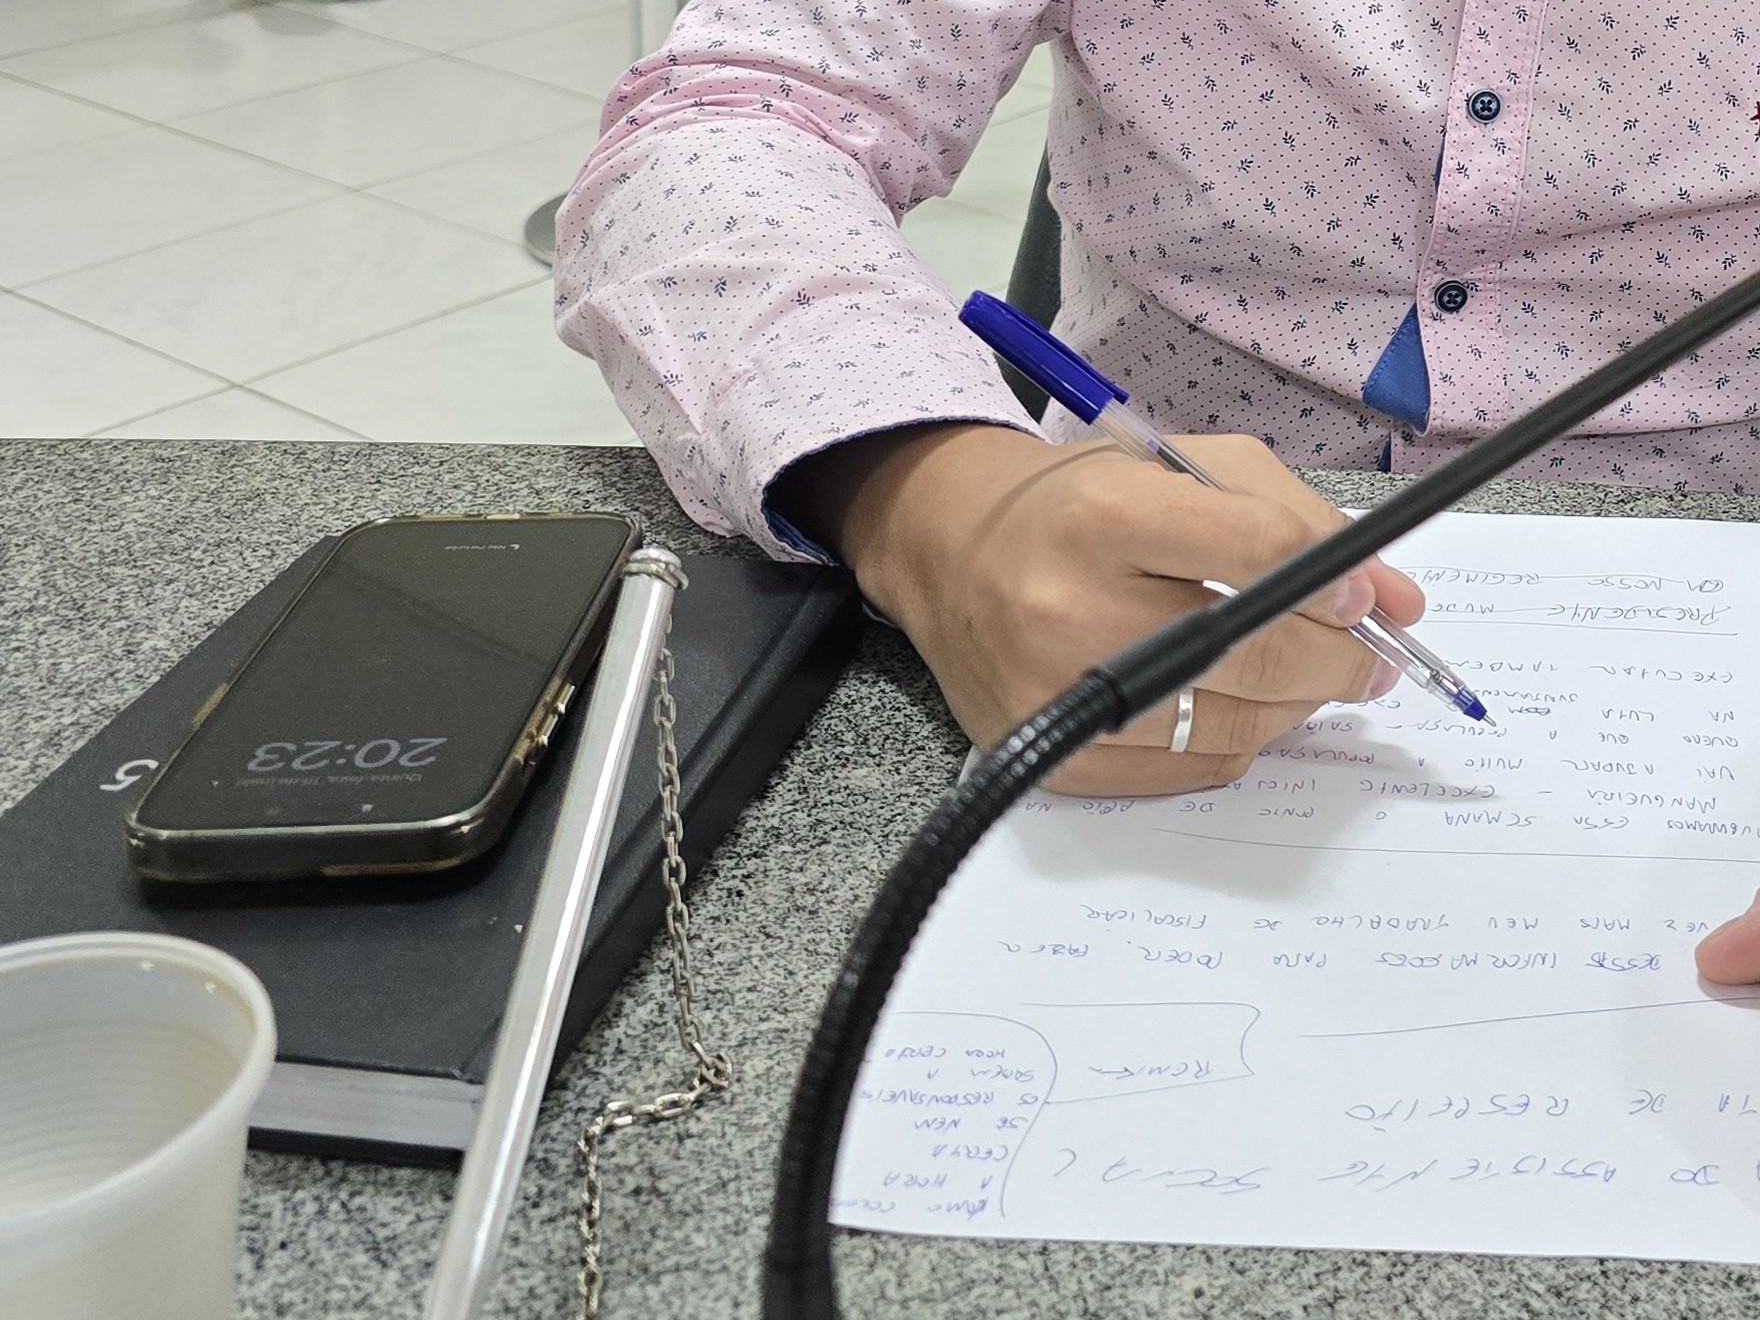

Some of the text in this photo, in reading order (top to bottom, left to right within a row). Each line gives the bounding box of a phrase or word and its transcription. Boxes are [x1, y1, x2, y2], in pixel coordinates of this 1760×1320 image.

[1708, 710, 1735, 721] NA
[1598, 732, 1630, 745] QUE
[247, 738, 447, 771] 20:23
[1696, 765, 1734, 780] VAI
[1179, 801, 1216, 814] DE
[1444, 811, 1537, 828] SEMANA
[1253, 918, 1282, 930] DE
[1488, 918, 1538, 930] MEU
[1579, 918, 1630, 931] MAIS
[1272, 953, 1327, 969] PARA
[1628, 1089, 1667, 1115] DE
[913, 1117, 961, 1131] NEM
[883, 1173, 948, 1188] HORA
[1669, 1163, 1720, 1187] DO
